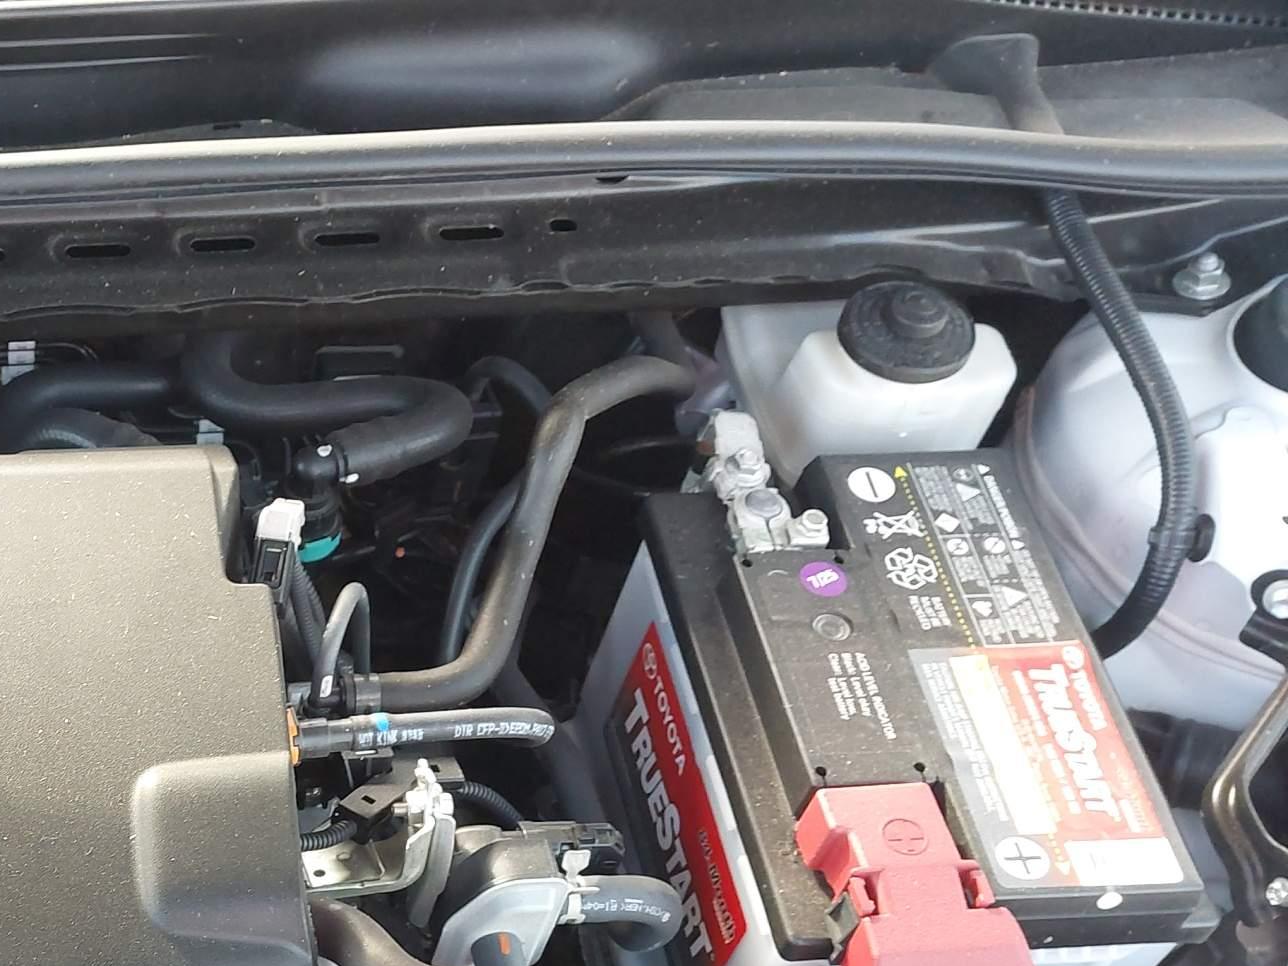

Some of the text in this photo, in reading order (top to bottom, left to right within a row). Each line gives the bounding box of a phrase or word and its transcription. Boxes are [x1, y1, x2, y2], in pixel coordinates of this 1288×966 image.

[652, 674, 686, 776] TOYOTA
[862, 671, 880, 696] LEVEL
[872, 695, 897, 739] INDICATOR
[624, 687, 713, 957] TRUESTART
